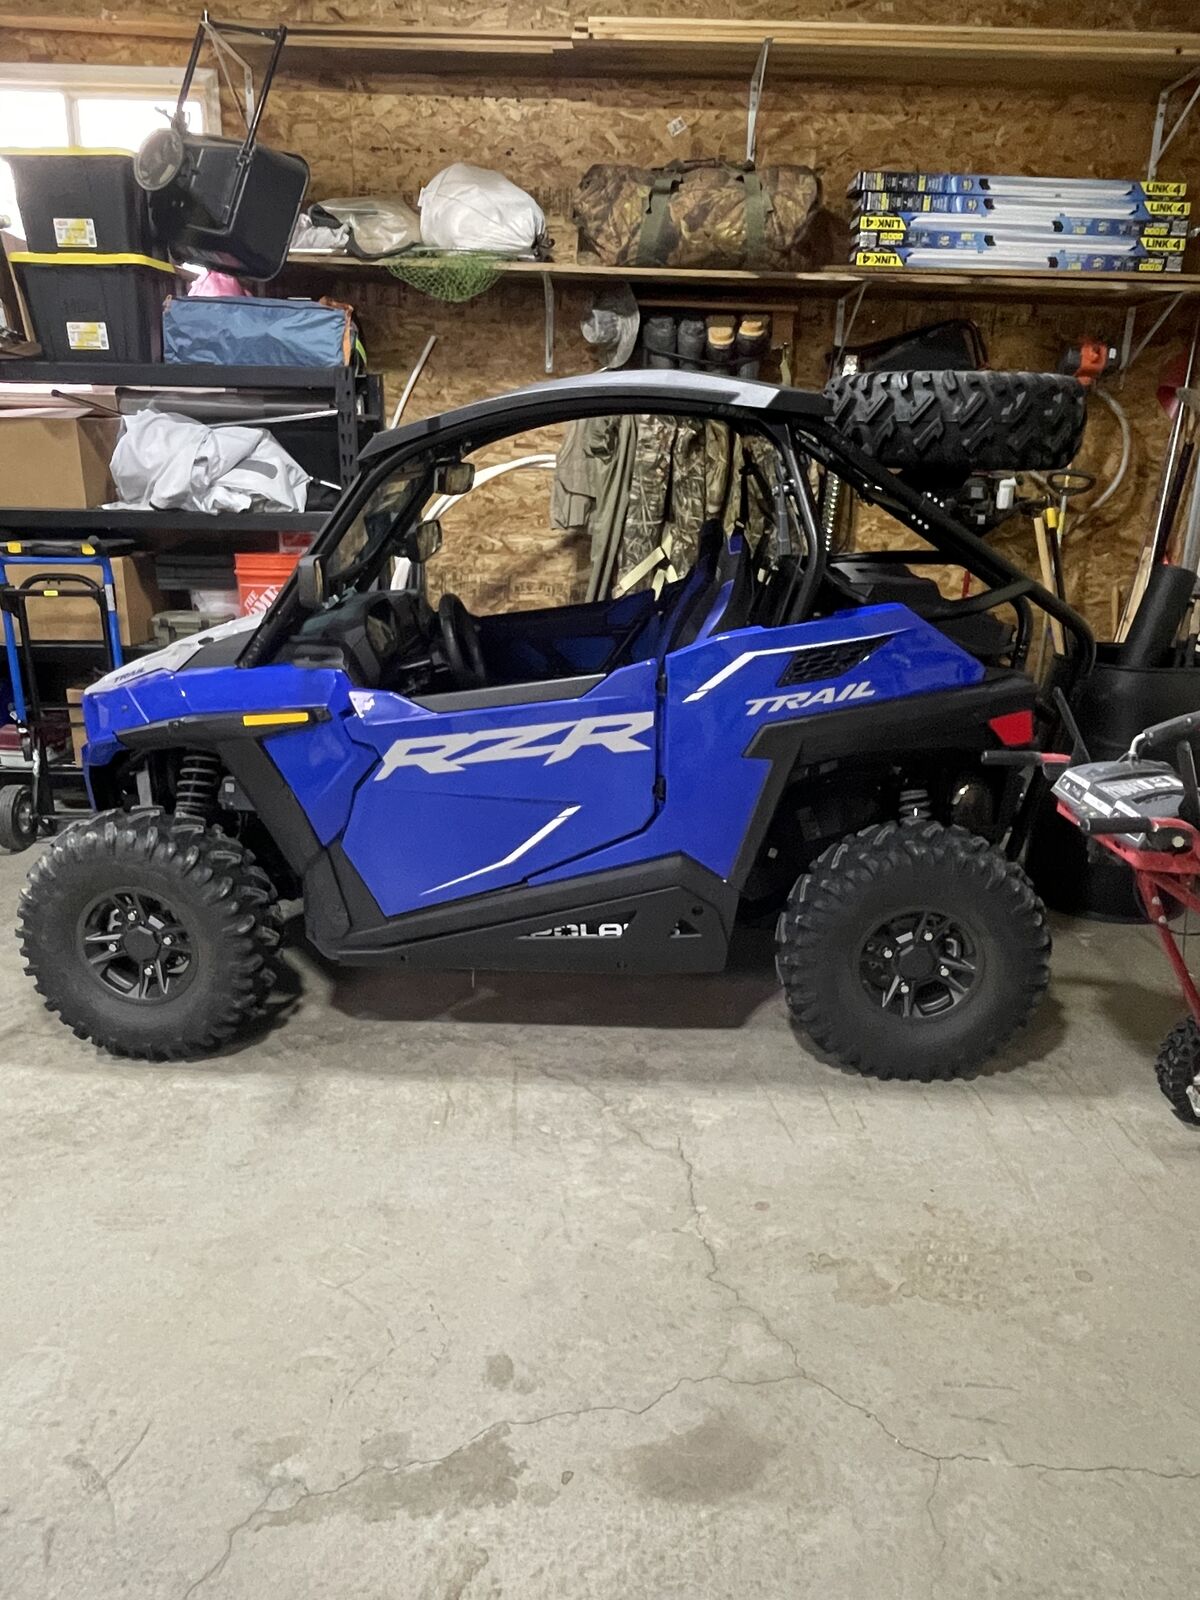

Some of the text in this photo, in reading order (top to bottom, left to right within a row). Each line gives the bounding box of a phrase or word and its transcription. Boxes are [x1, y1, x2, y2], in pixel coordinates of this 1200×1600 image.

[1146, 183, 1181, 196] LINK 4
[1150, 203, 1185, 215] LINK 4
[866, 217, 901, 229] LINK 4
[1146, 238, 1181, 250] LINK 4
[863, 254, 897, 265] LINK 4
[243, 589, 259, 611] THE
[745, 681, 876, 716] TRAIL
[374, 710, 654, 782] RZR
[529, 922, 630, 938] OLA
